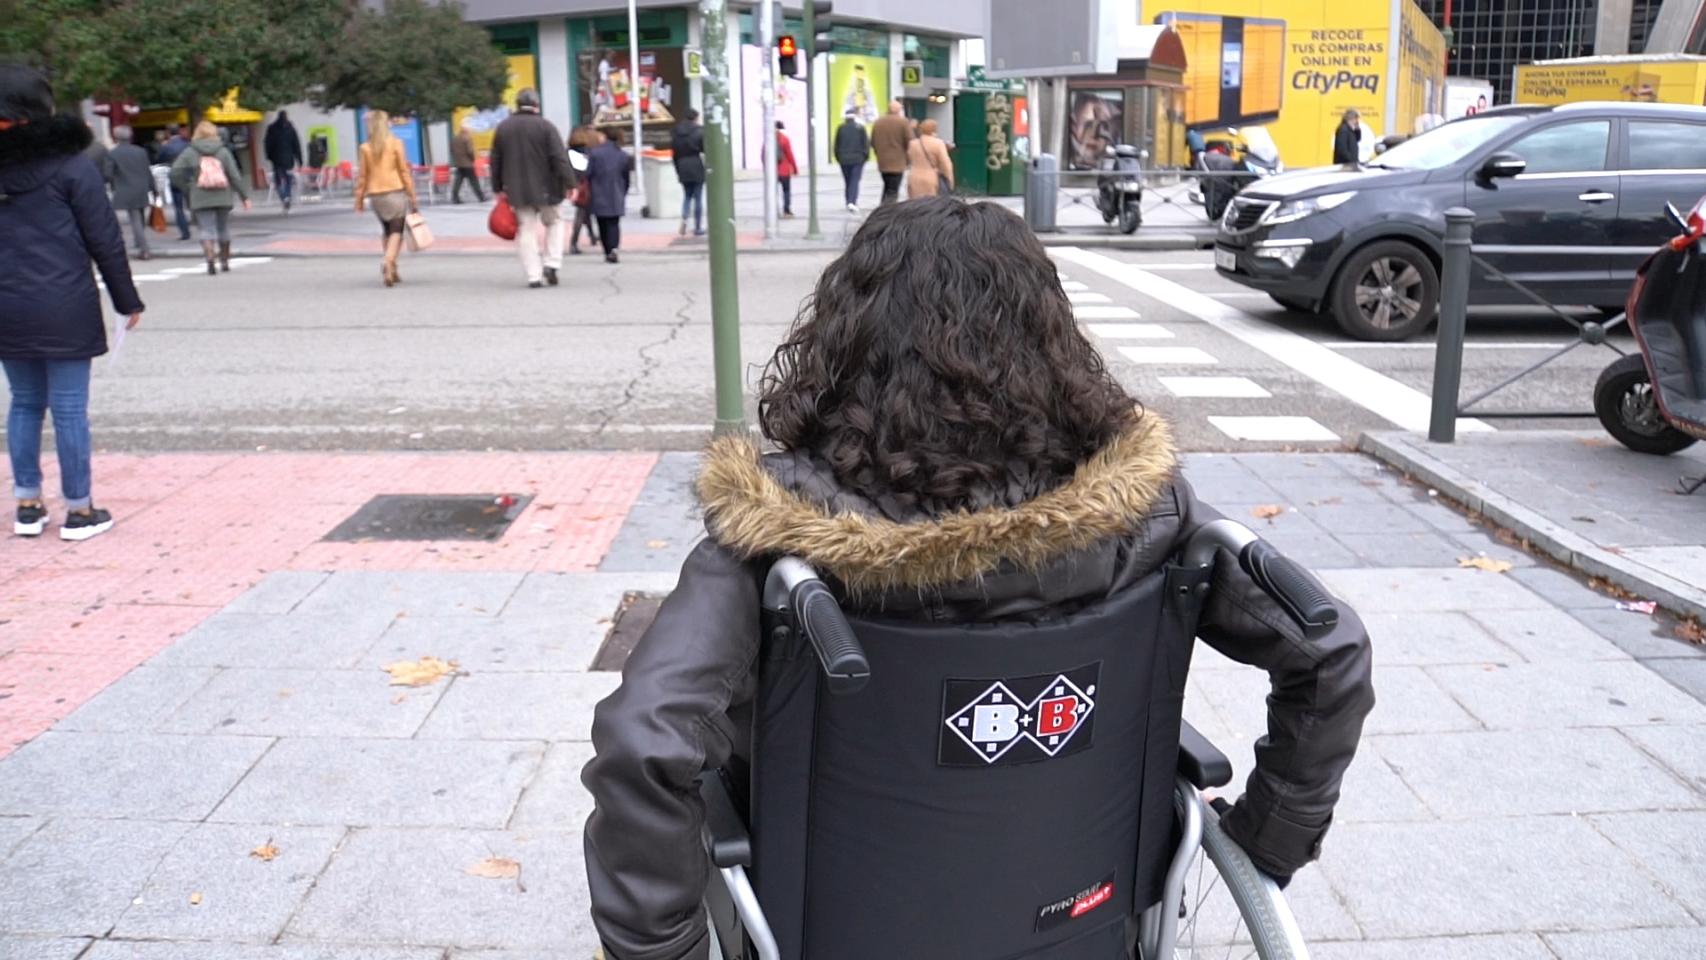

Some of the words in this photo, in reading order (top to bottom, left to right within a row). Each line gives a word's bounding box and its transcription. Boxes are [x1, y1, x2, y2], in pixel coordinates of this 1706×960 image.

[1311, 30, 1364, 40] RECOGE
[1292, 43, 1315, 53] TUS
[1318, 43, 1384, 53] COMPRAS
[1301, 56, 1350, 66] ONLINE
[1354, 56, 1372, 66] EN
[1567, 69, 1606, 77] COMPRAS
[1292, 70, 1379, 95] CityPaq
[1566, 78, 1602, 86] ESPERAN
[1040, 897, 1075, 917] PYRO
